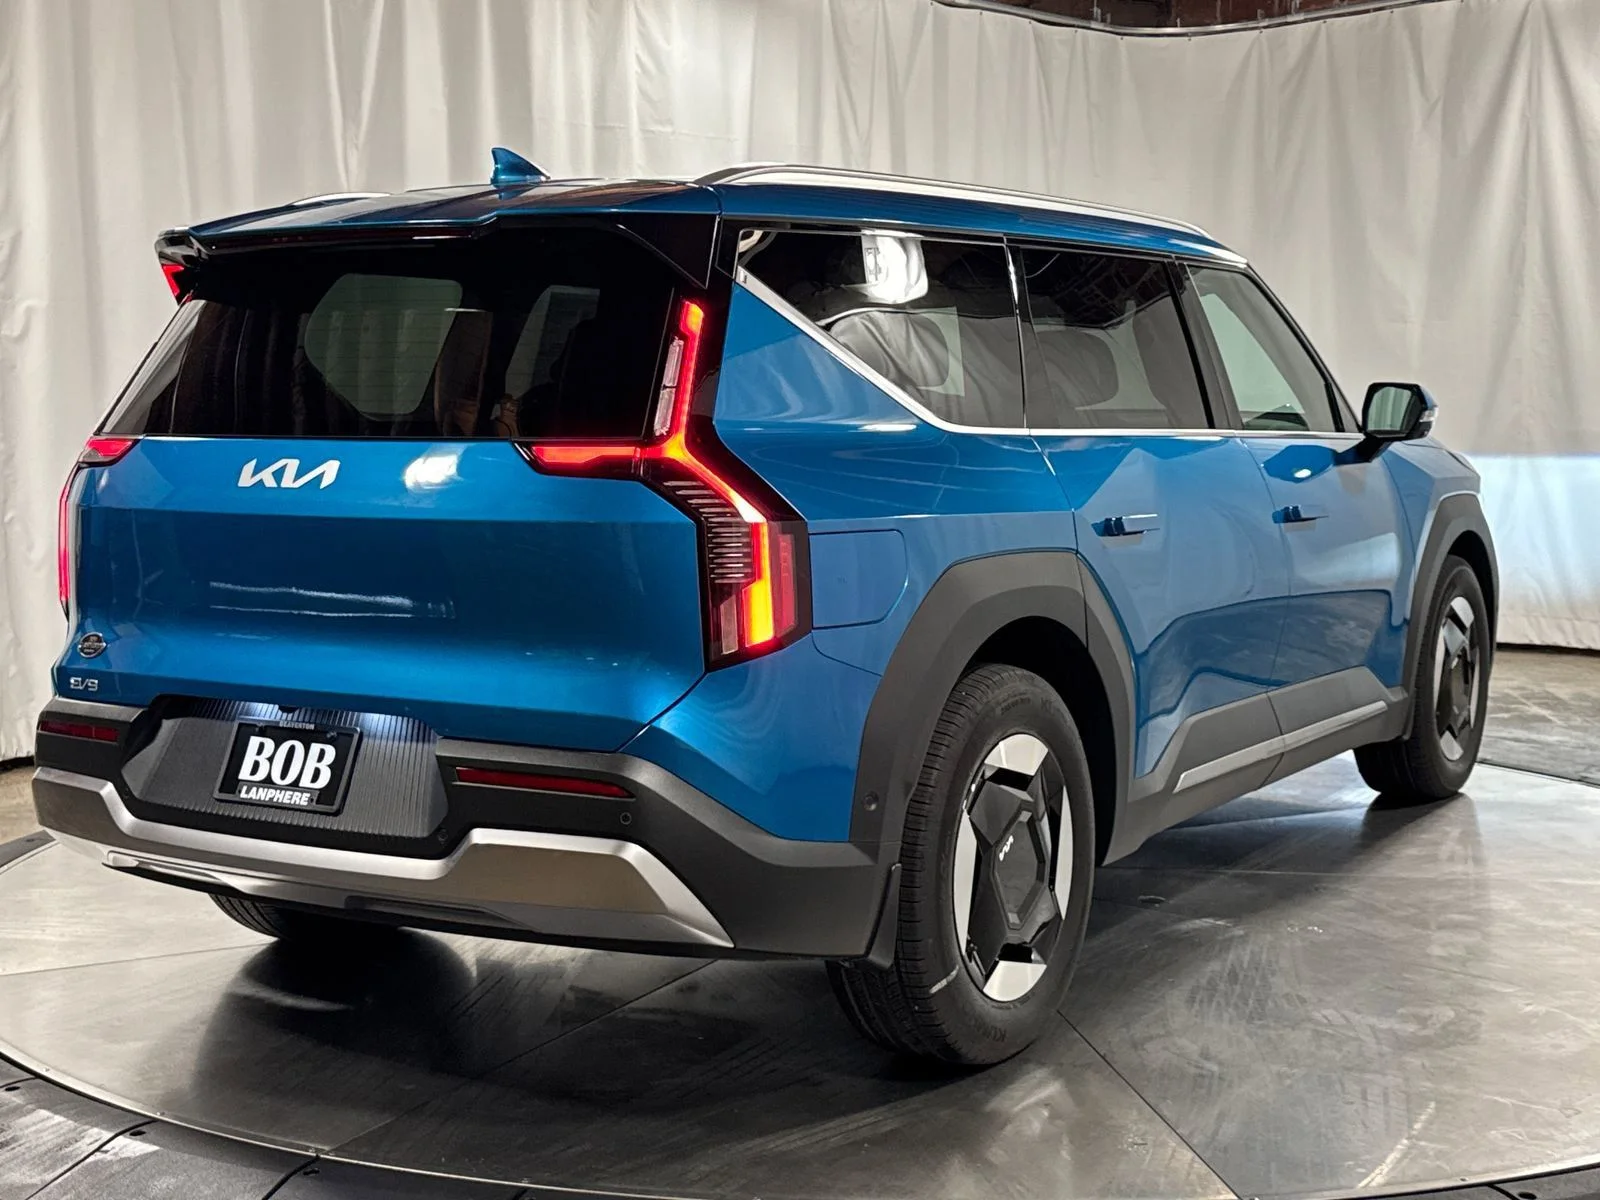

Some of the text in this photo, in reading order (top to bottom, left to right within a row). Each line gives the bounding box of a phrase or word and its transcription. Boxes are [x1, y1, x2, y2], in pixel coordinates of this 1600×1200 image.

[238, 458, 340, 489] KIA
[238, 735, 336, 789] BOB
[240, 785, 311, 806] LANPHERE
